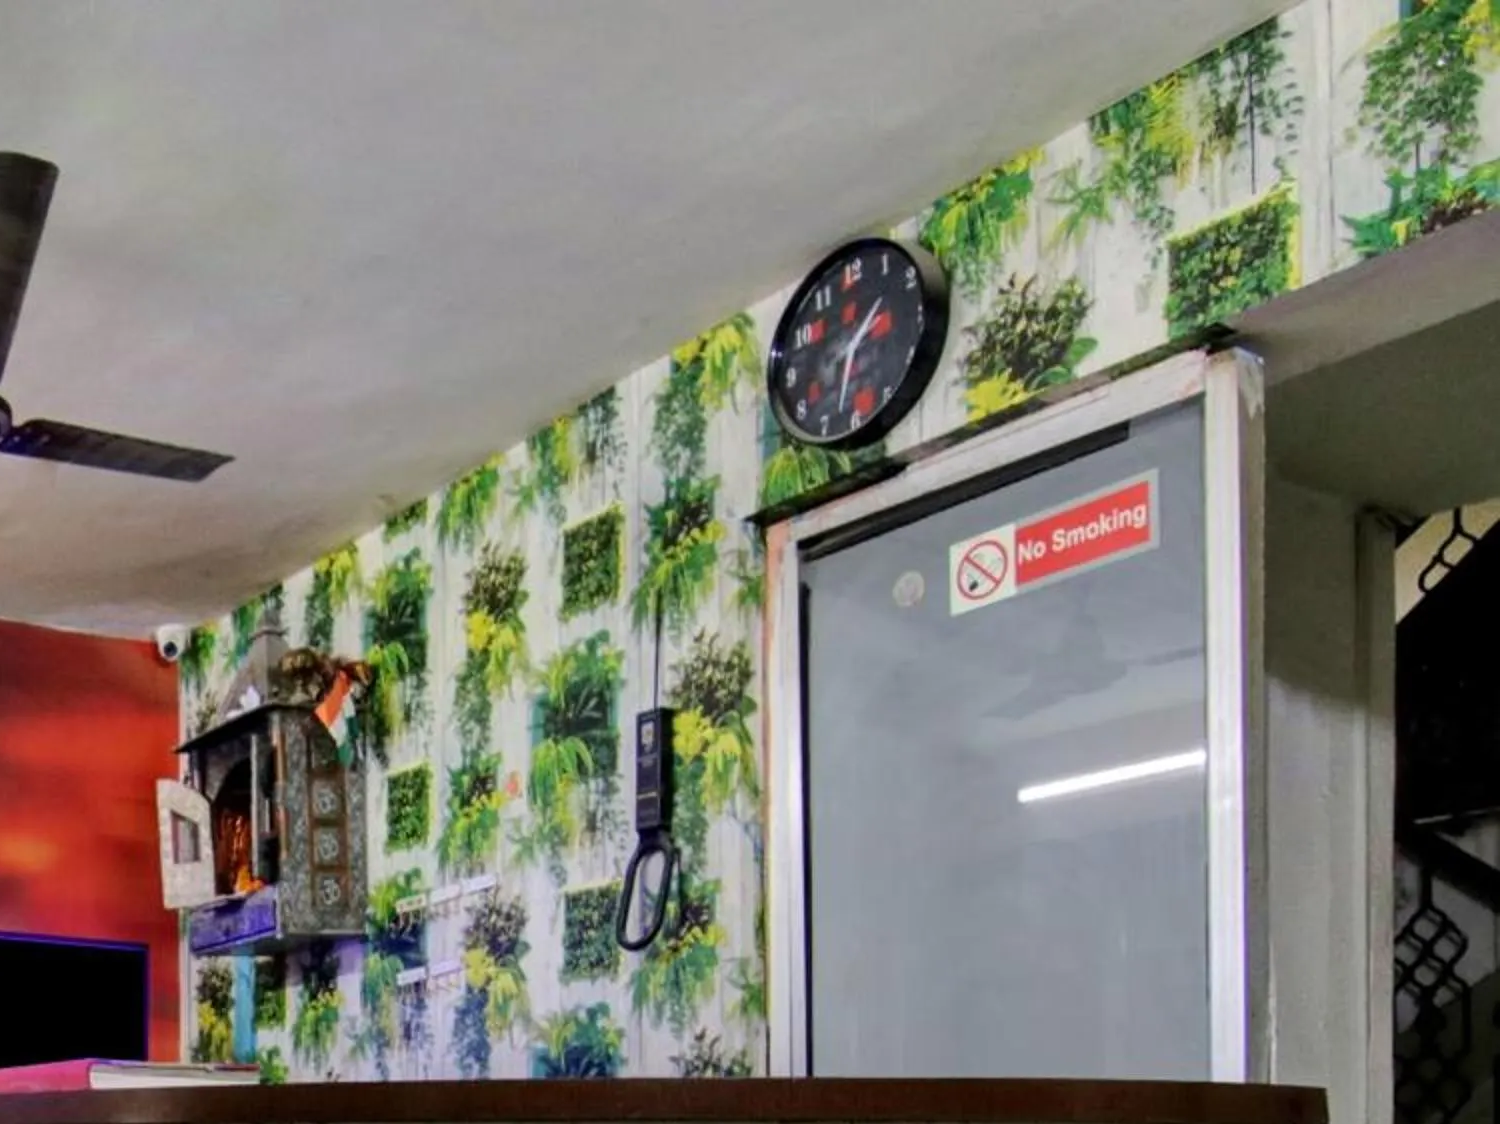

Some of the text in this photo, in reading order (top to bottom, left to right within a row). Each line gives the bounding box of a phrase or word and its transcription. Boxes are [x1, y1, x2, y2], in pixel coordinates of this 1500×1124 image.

[843, 257, 861, 287] 12
[881, 253, 888, 276] 1
[905, 266, 916, 289] 2
[815, 285, 831, 311] 11
[796, 322, 812, 349] 10
[786, 367, 797, 388] 9
[797, 399, 807, 420] 8
[851, 410, 861, 432] 6
[820, 415, 829, 437] 7
[1018, 503, 1147, 565] No Smoking
